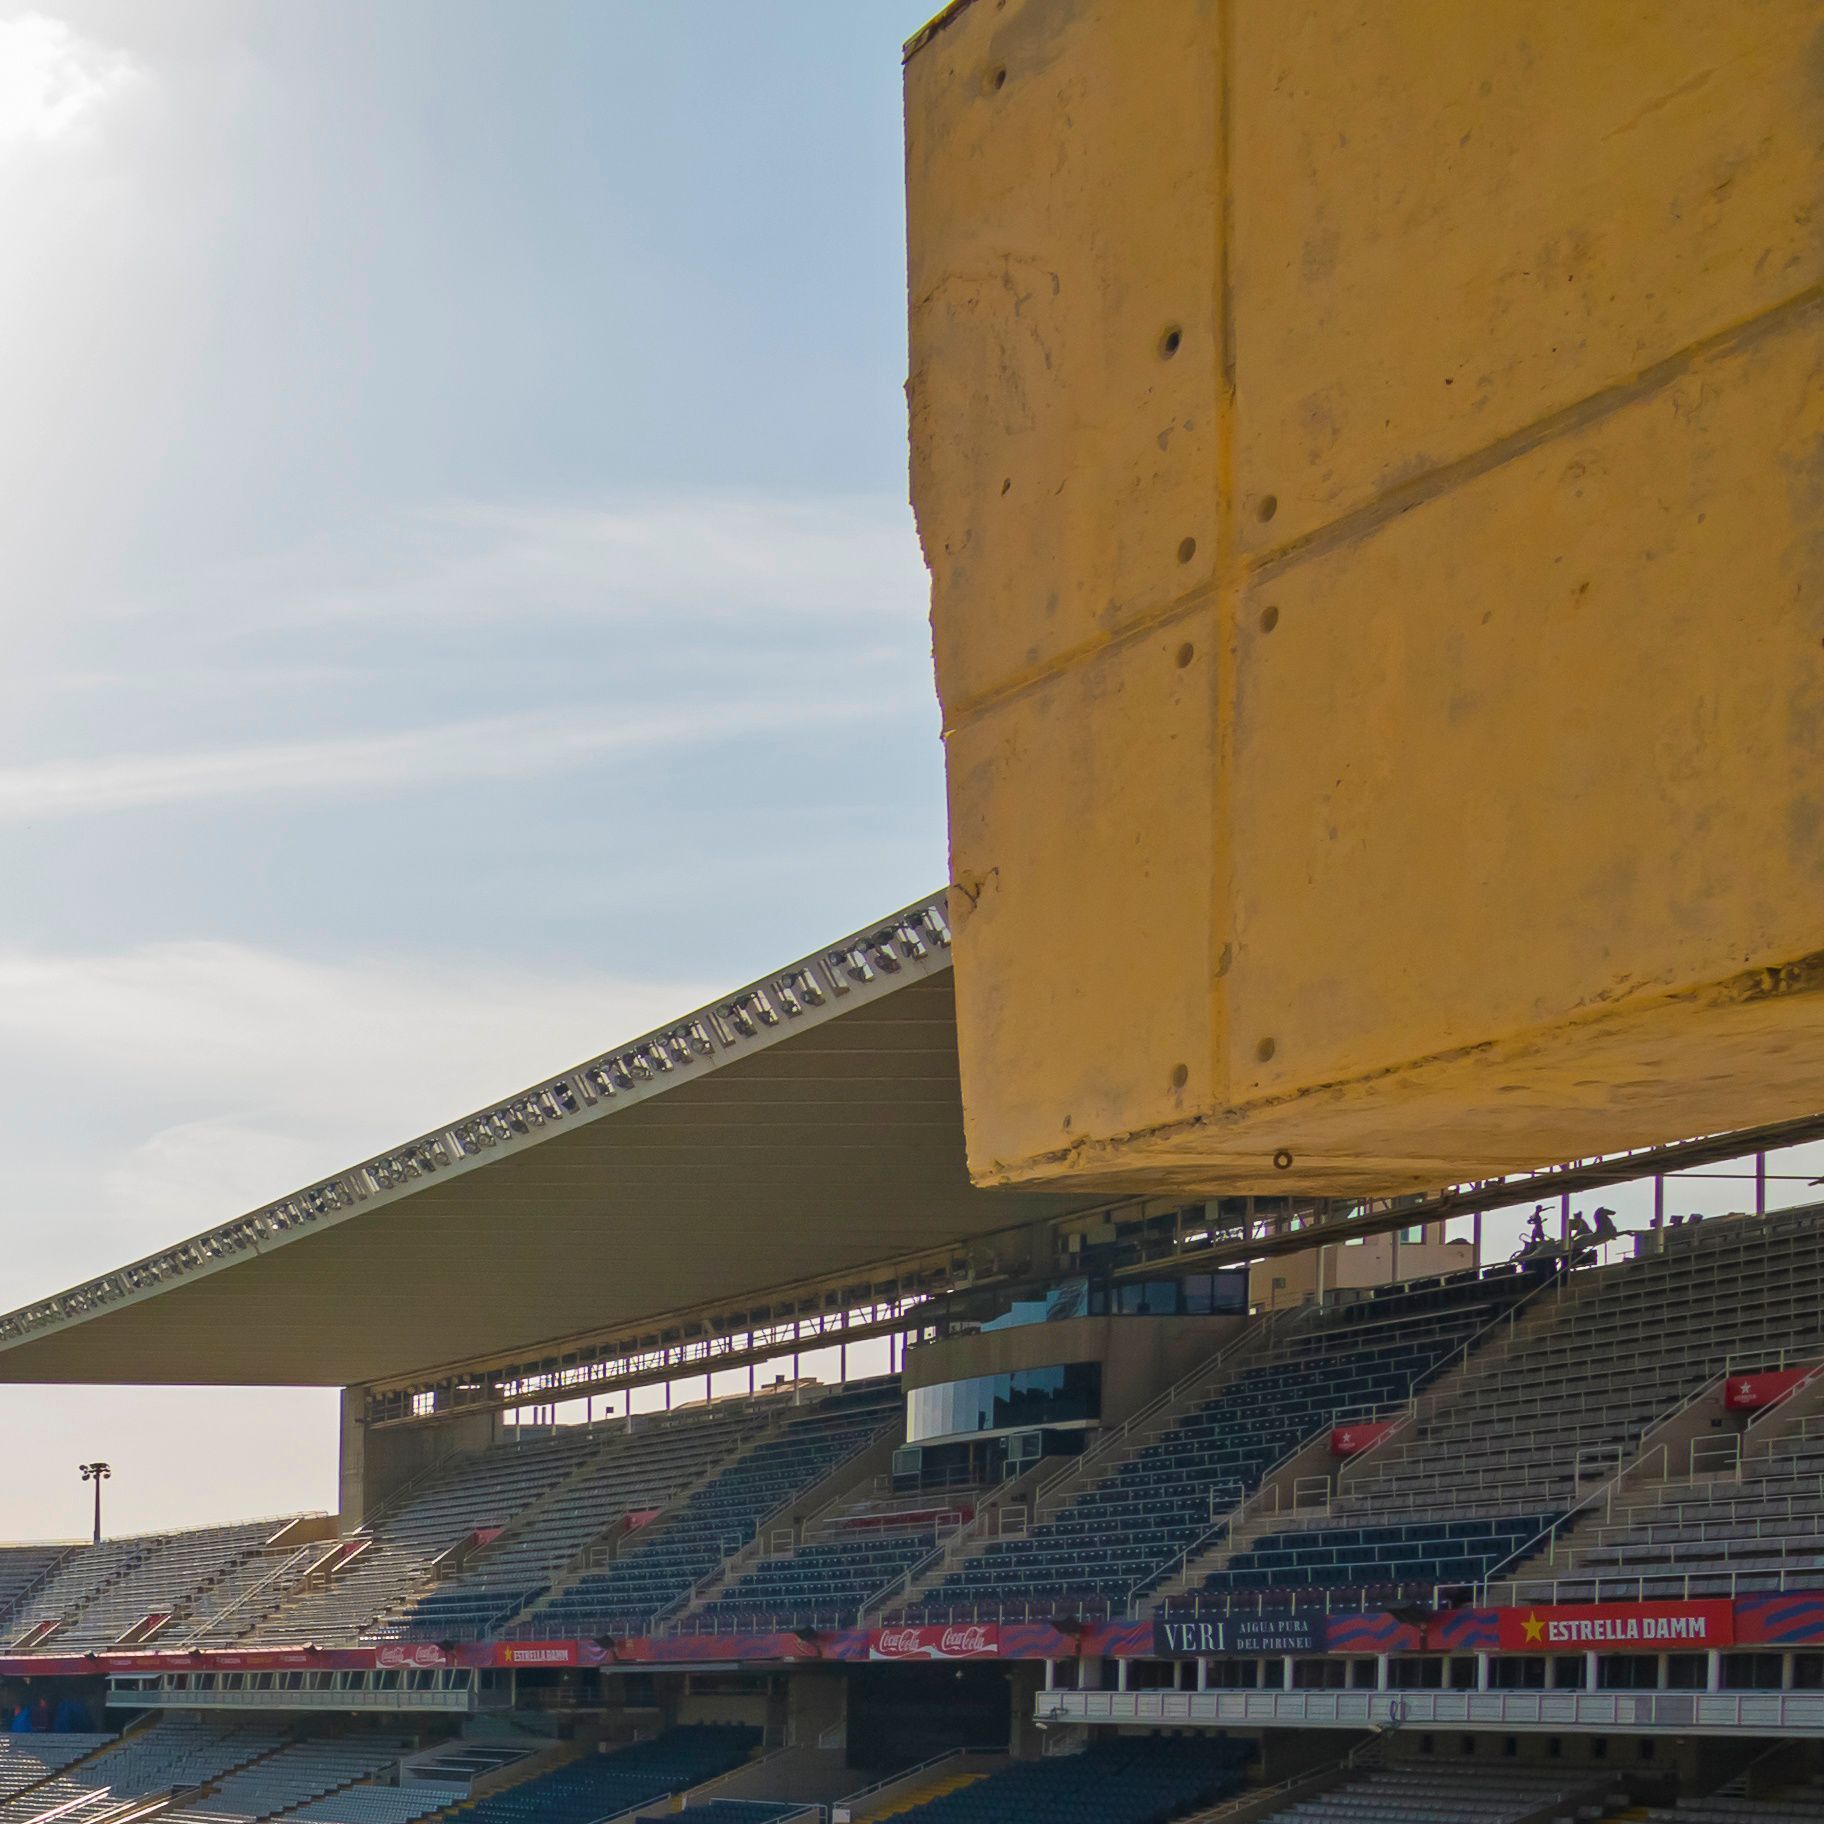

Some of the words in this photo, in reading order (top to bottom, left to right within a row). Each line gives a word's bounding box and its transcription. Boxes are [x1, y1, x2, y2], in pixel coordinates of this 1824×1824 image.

[941, 1626, 991, 1651] Coca-Cola
[1164, 1623, 1226, 1651] VERI
[1239, 1622, 1274, 1634] AIGUA
[1278, 1620, 1309, 1633] PURA
[1548, 1618, 1639, 1641] ESTRELLA
[1642, 1616, 1707, 1639] DAMM
[879, 1628, 923, 1652] Coca-Cola
[1237, 1637, 1260, 1650] DEL
[1262, 1636, 1313, 1649] PIRINEU
